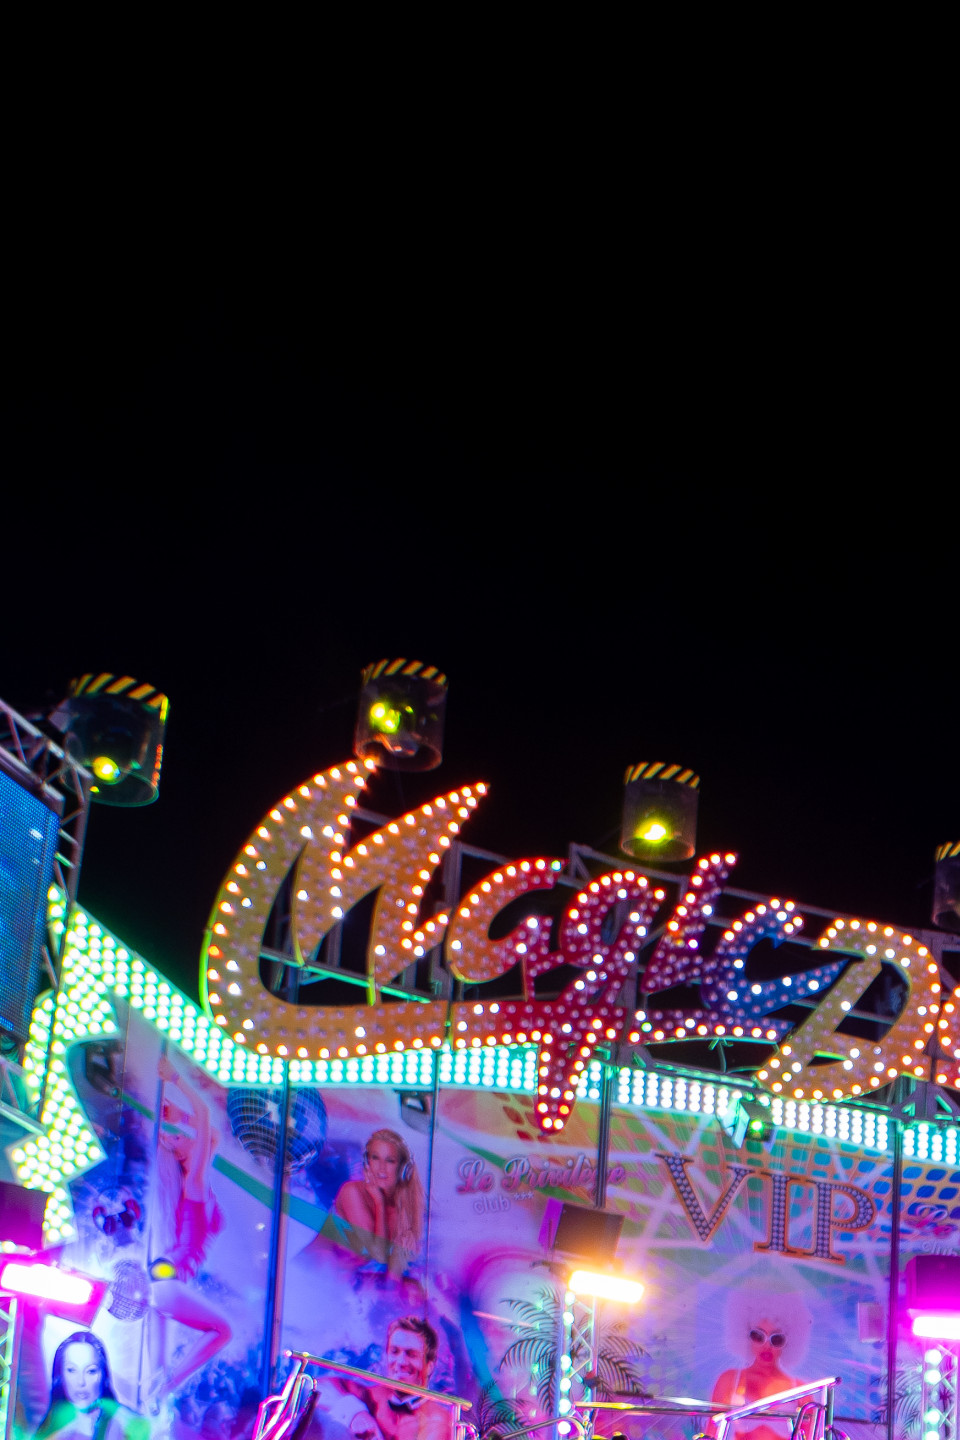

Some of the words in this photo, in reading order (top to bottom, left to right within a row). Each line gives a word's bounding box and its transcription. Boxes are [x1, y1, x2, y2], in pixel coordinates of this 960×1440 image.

[201, 756, 848, 1135] Magic
[455, 1157, 495, 1194] Le
[501, 1152, 626, 1194] Privilèe
[472, 1195, 511, 1215] club
[654, 1152, 877, 1265] VIP
